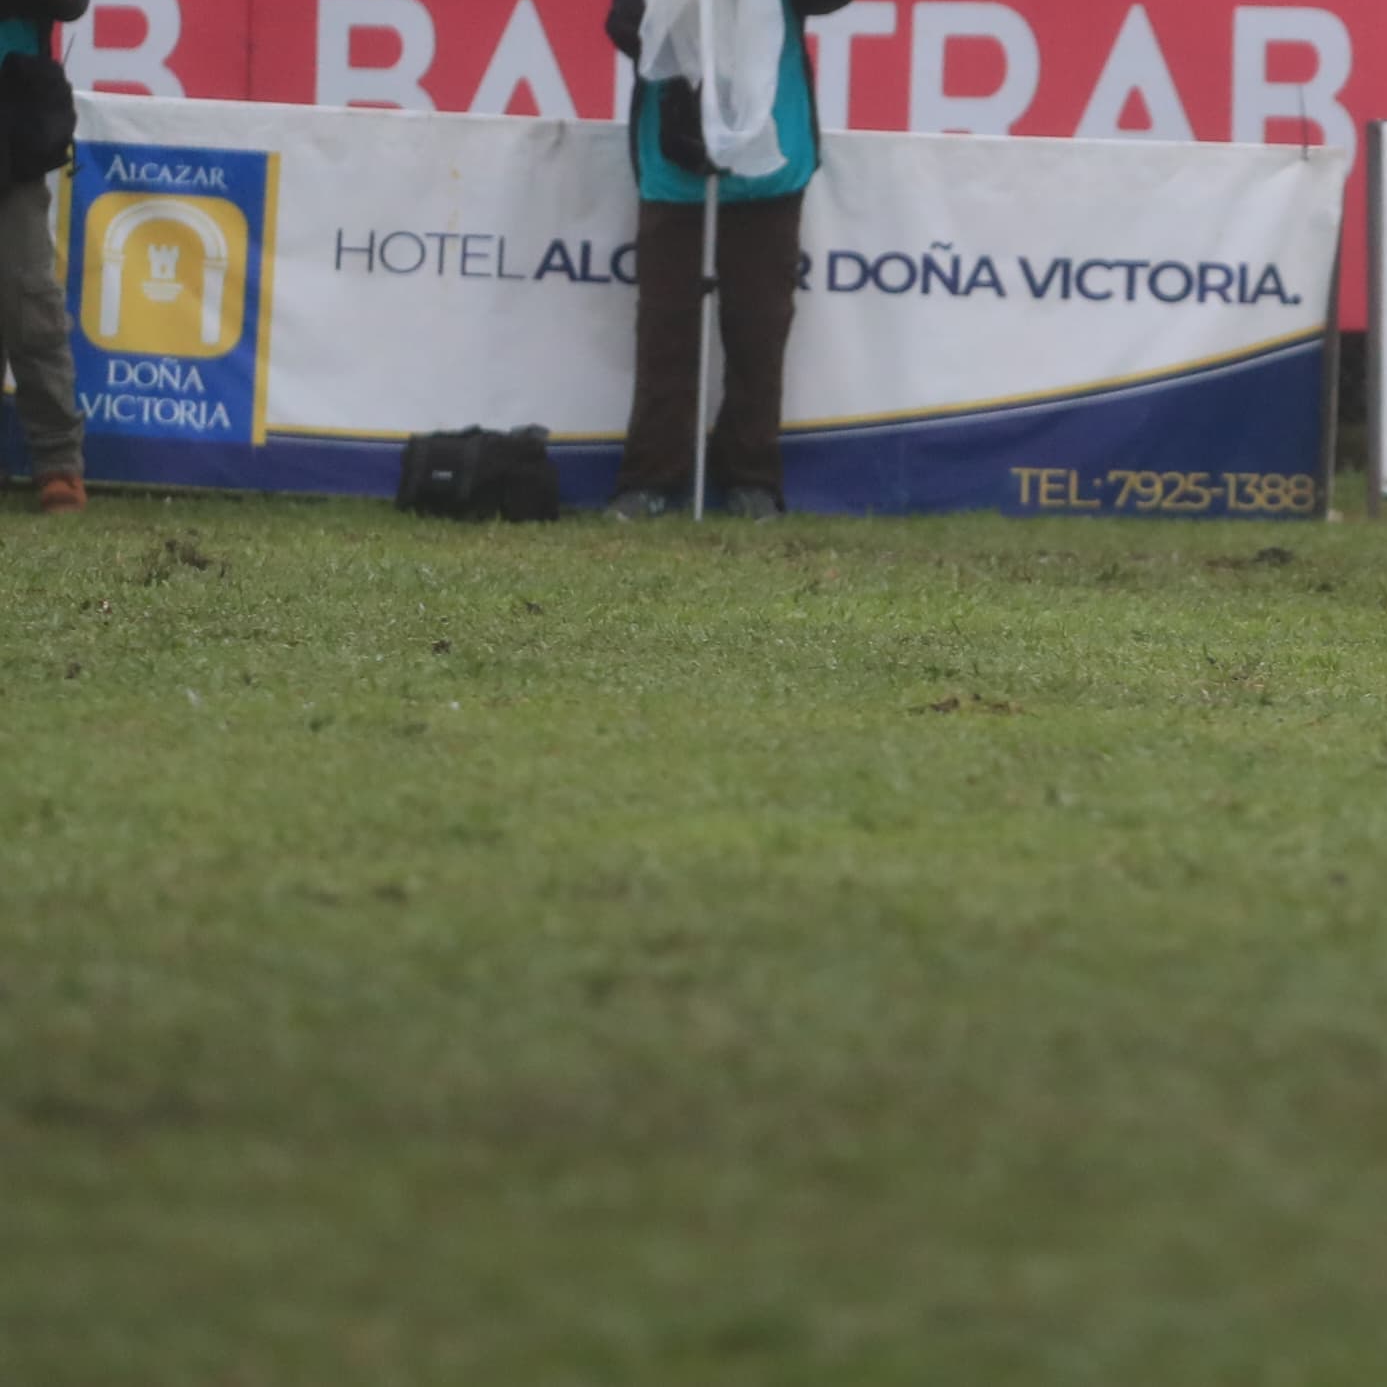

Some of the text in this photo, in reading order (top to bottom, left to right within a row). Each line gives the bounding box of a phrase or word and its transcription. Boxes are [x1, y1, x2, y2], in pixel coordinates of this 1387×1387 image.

[104, 154, 228, 191] ALCAZAR
[334, 228, 526, 281] HOTEL
[827, 241, 1006, 298] DOÑA
[1018, 256, 1302, 306] VICTORIA.
[106, 357, 206, 393] DOÑA
[80, 392, 231, 430] VICTORIA
[1107, 469, 1315, 512] 7925-1388
